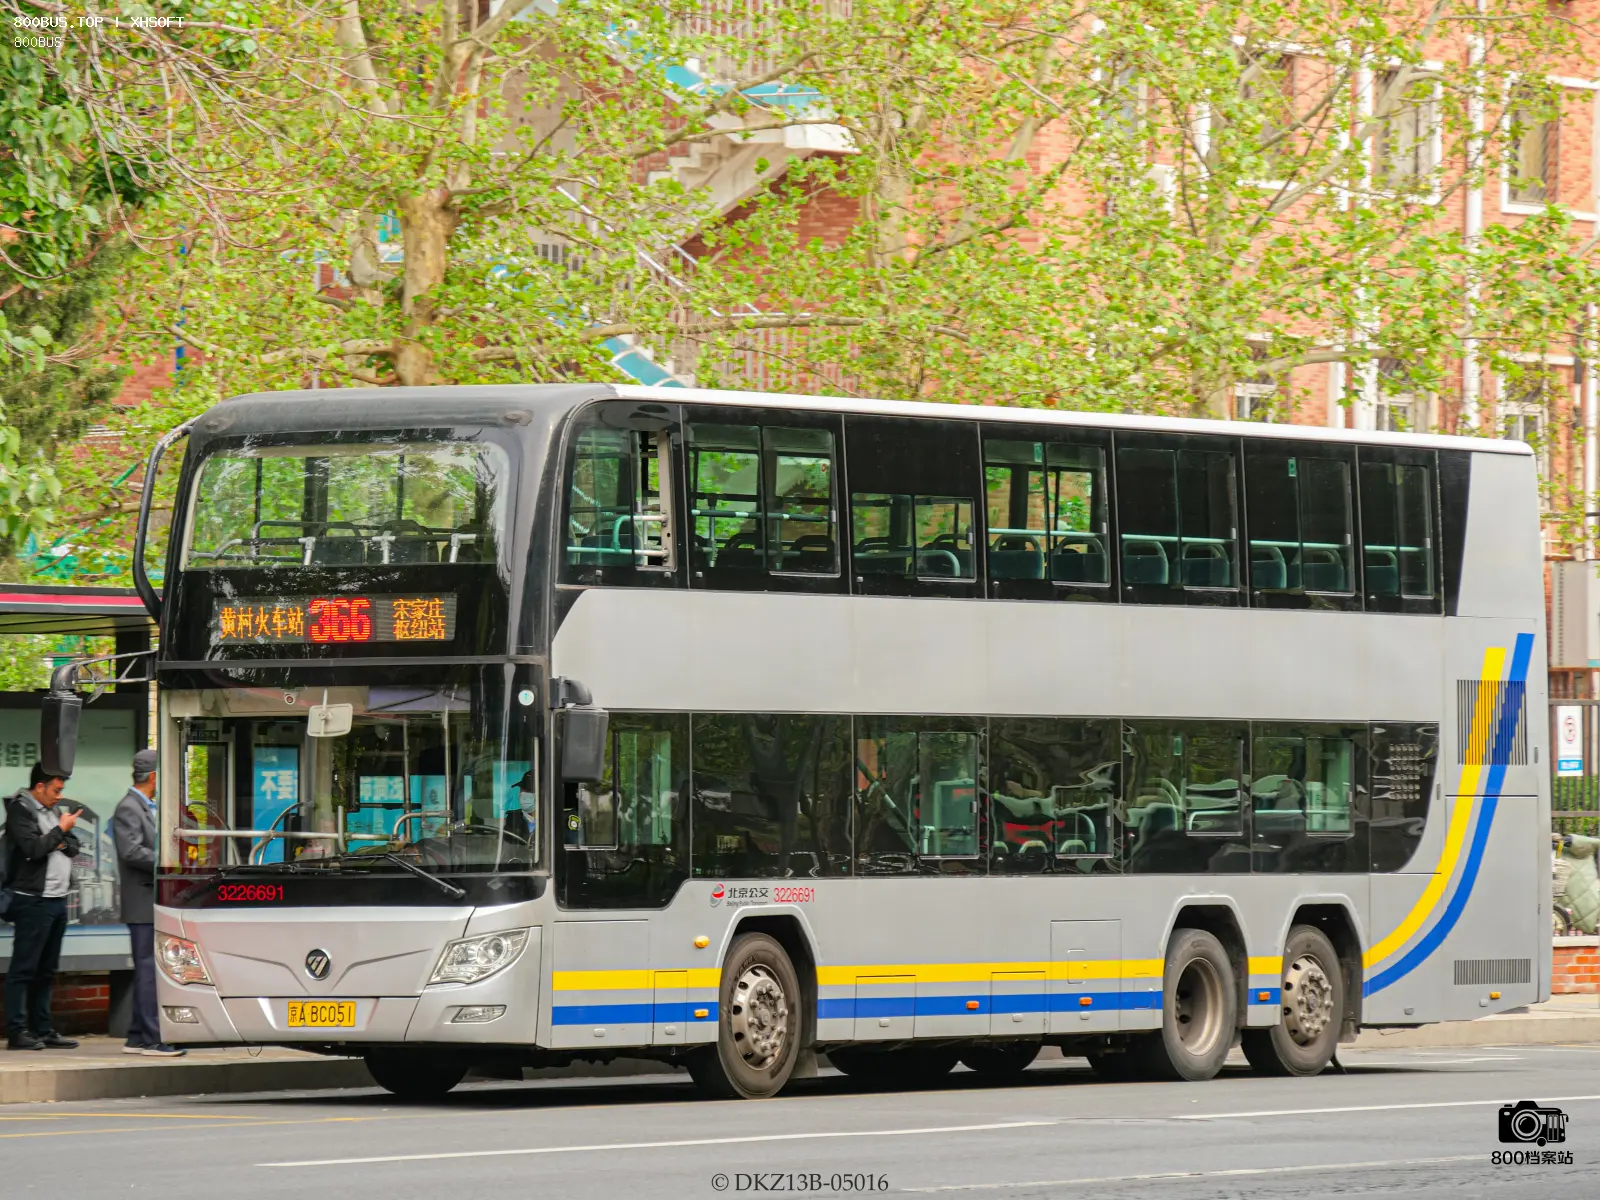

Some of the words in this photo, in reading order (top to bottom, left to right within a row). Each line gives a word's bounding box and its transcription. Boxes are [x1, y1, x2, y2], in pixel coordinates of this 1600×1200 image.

[392, 598, 446, 619] 宋家庄
[219, 606, 305, 639] 黄村火车站
[309, 597, 372, 642] 366
[392, 619, 446, 640] 枢纽站
[261, 769, 298, 800] 不要
[218, 884, 284, 901] 3226691
[727, 887, 769, 899] 北京公交
[773, 887, 815, 903] 3226691
